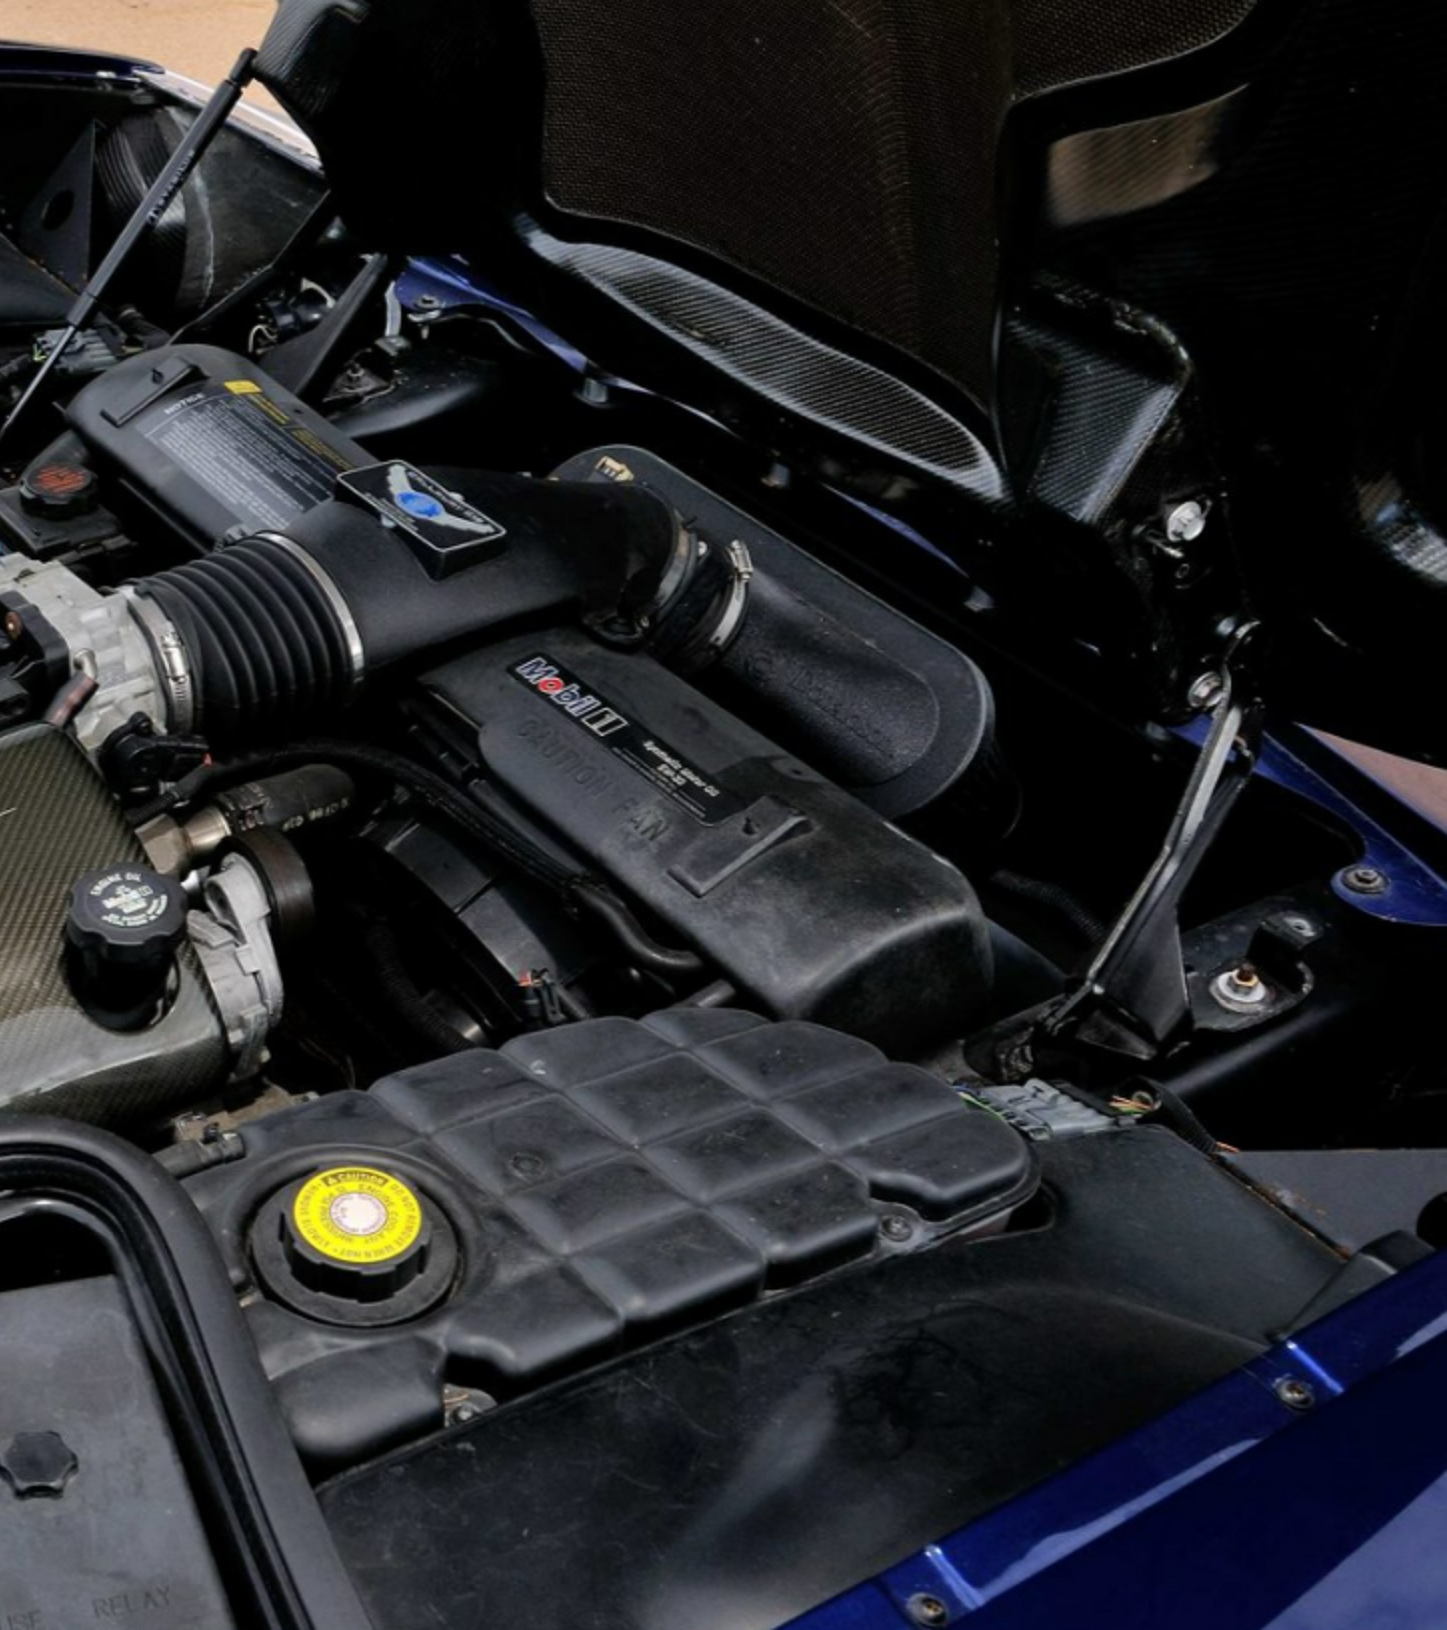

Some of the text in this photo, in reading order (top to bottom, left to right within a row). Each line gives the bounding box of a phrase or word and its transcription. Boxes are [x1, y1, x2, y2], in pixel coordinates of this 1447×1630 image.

[514, 656, 622, 735] Mobil 1
[518, 717, 613, 798] CAUTION
[611, 796, 672, 842] FAN
[338, 1173, 385, 1186] CAUTION
[92, 1584, 170, 1618] RELAY
